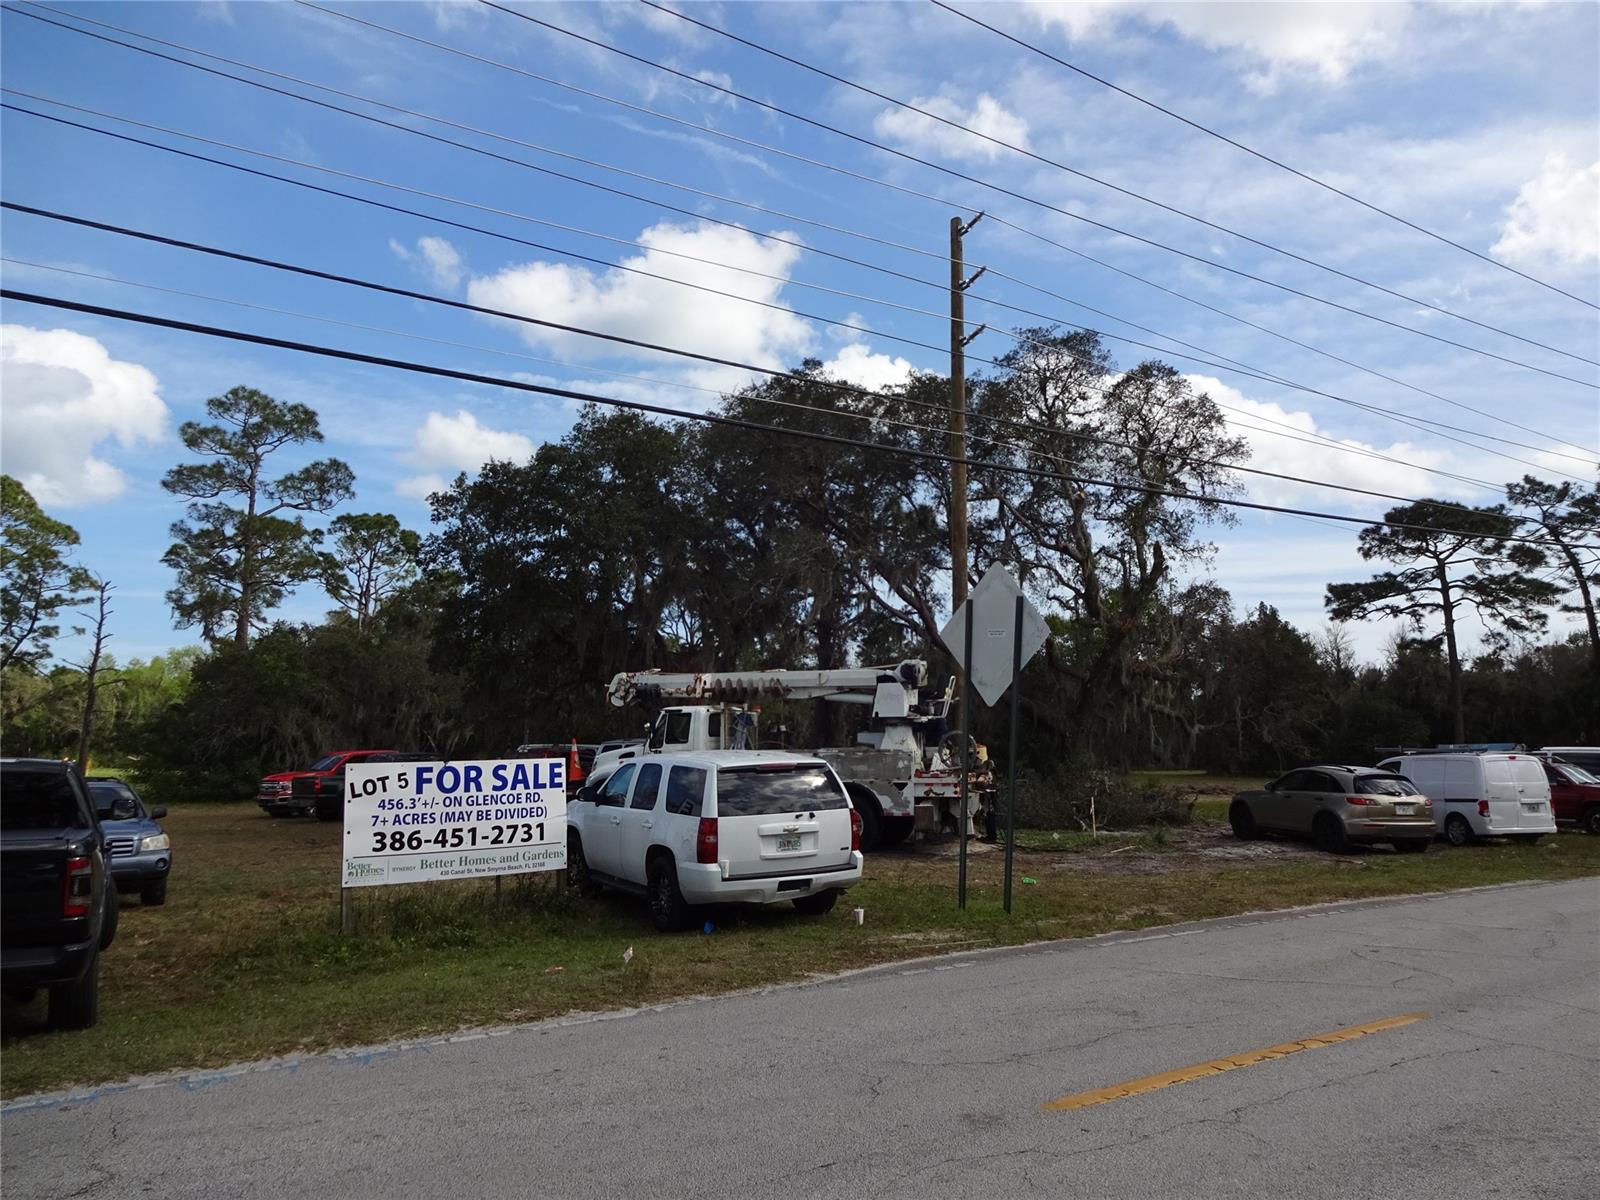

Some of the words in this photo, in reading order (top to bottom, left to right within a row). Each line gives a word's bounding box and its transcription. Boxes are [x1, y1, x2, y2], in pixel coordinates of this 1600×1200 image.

[350, 776, 390, 799] LOT
[397, 772, 409, 789] 5
[416, 766, 482, 794] FOR
[492, 763, 562, 791] SALE
[442, 796, 462, 808] ON
[466, 793, 522, 806] GLENCOE
[525, 791, 544, 804] RD.
[371, 815, 389, 827] 7+
[392, 812, 436, 826] ACRES
[439, 810, 473, 825] (MAY
[476, 808, 492, 821] BE
[495, 806, 548, 820] DIVIDED)
[372, 822, 544, 852] 386-451-2731
[347, 861, 373, 870] Better
[420, 858, 456, 870] Better
[458, 855, 496, 868] Homes
[500, 852, 520, 863] and
[522, 849, 564, 861] Gardens
[355, 866, 384, 877] Homes
[488, 866, 507, 874] Smyrna
